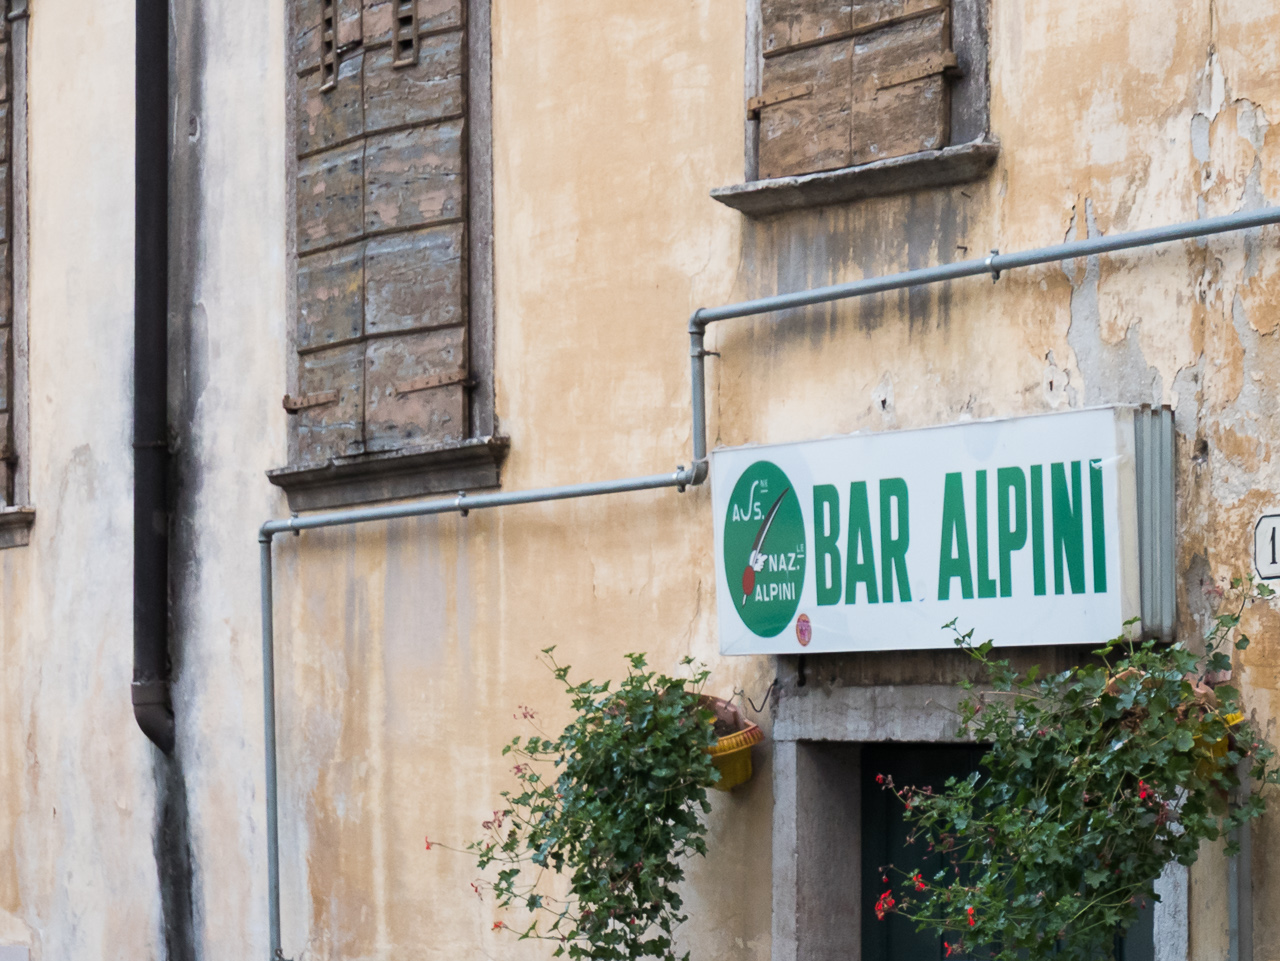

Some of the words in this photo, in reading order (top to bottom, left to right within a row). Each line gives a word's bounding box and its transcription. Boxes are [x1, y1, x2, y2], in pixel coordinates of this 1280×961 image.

[813, 477, 912, 606] BAR
[937, 459, 1107, 601] ALPINI
[755, 582, 796, 602] ALPINI
